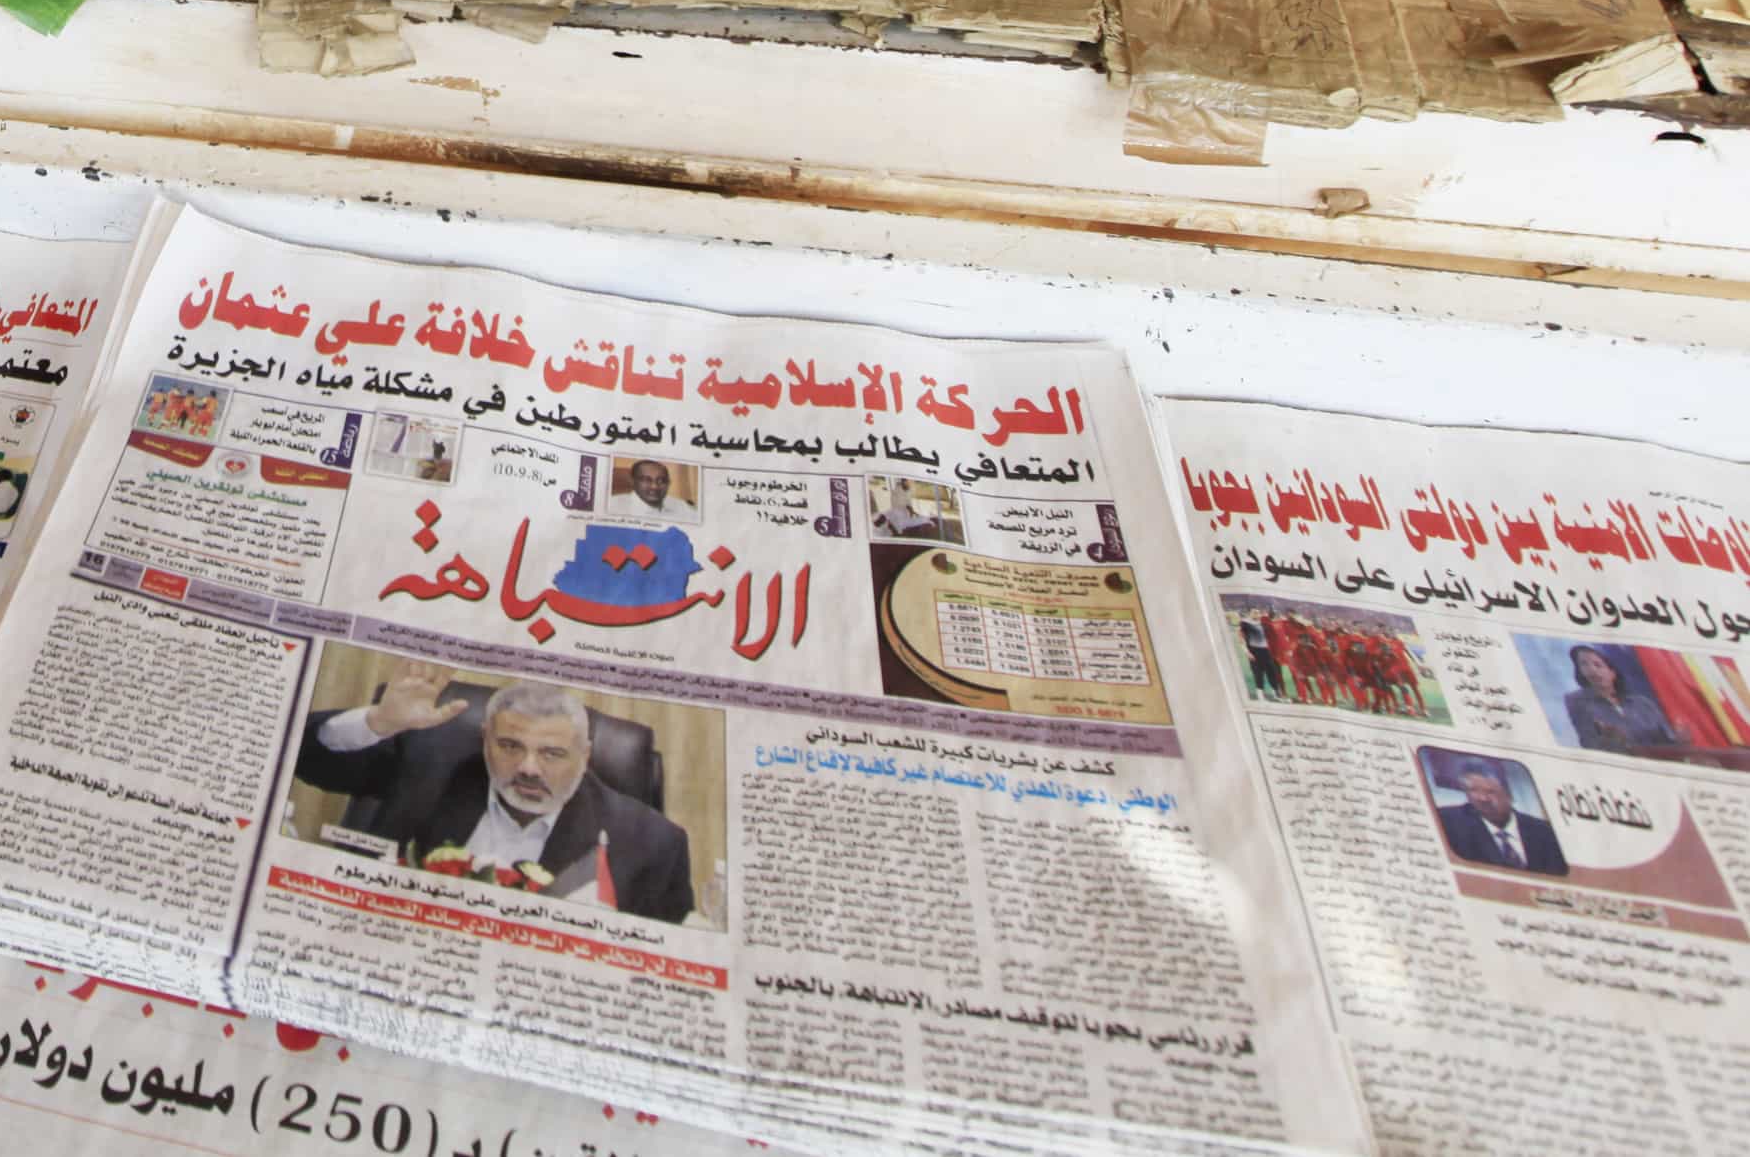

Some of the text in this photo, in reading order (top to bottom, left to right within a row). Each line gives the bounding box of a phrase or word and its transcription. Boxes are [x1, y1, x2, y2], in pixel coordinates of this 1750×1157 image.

[177, 269, 1085, 448] الحركة الإسلامية تناقش خلافة علي عثمان
[166, 334, 1097, 488] المتعافي يطالب بمحاسبة المتورطين في مشكلة مياه الجزيرة
[321, 449, 338, 464] 15
[1180, 455, 1560, 575] بين بجوبا
[377, 498, 811, 662] الانتباهة
[1210, 540, 1684, 630] العدوان على السودان
[805, 727, 1116, 777] كشف عن بشريات كبيرة للشعب السوداني
[1557, 784, 1654, 830] نقطة نظام
[98, 1057, 235, 1117] مليون
